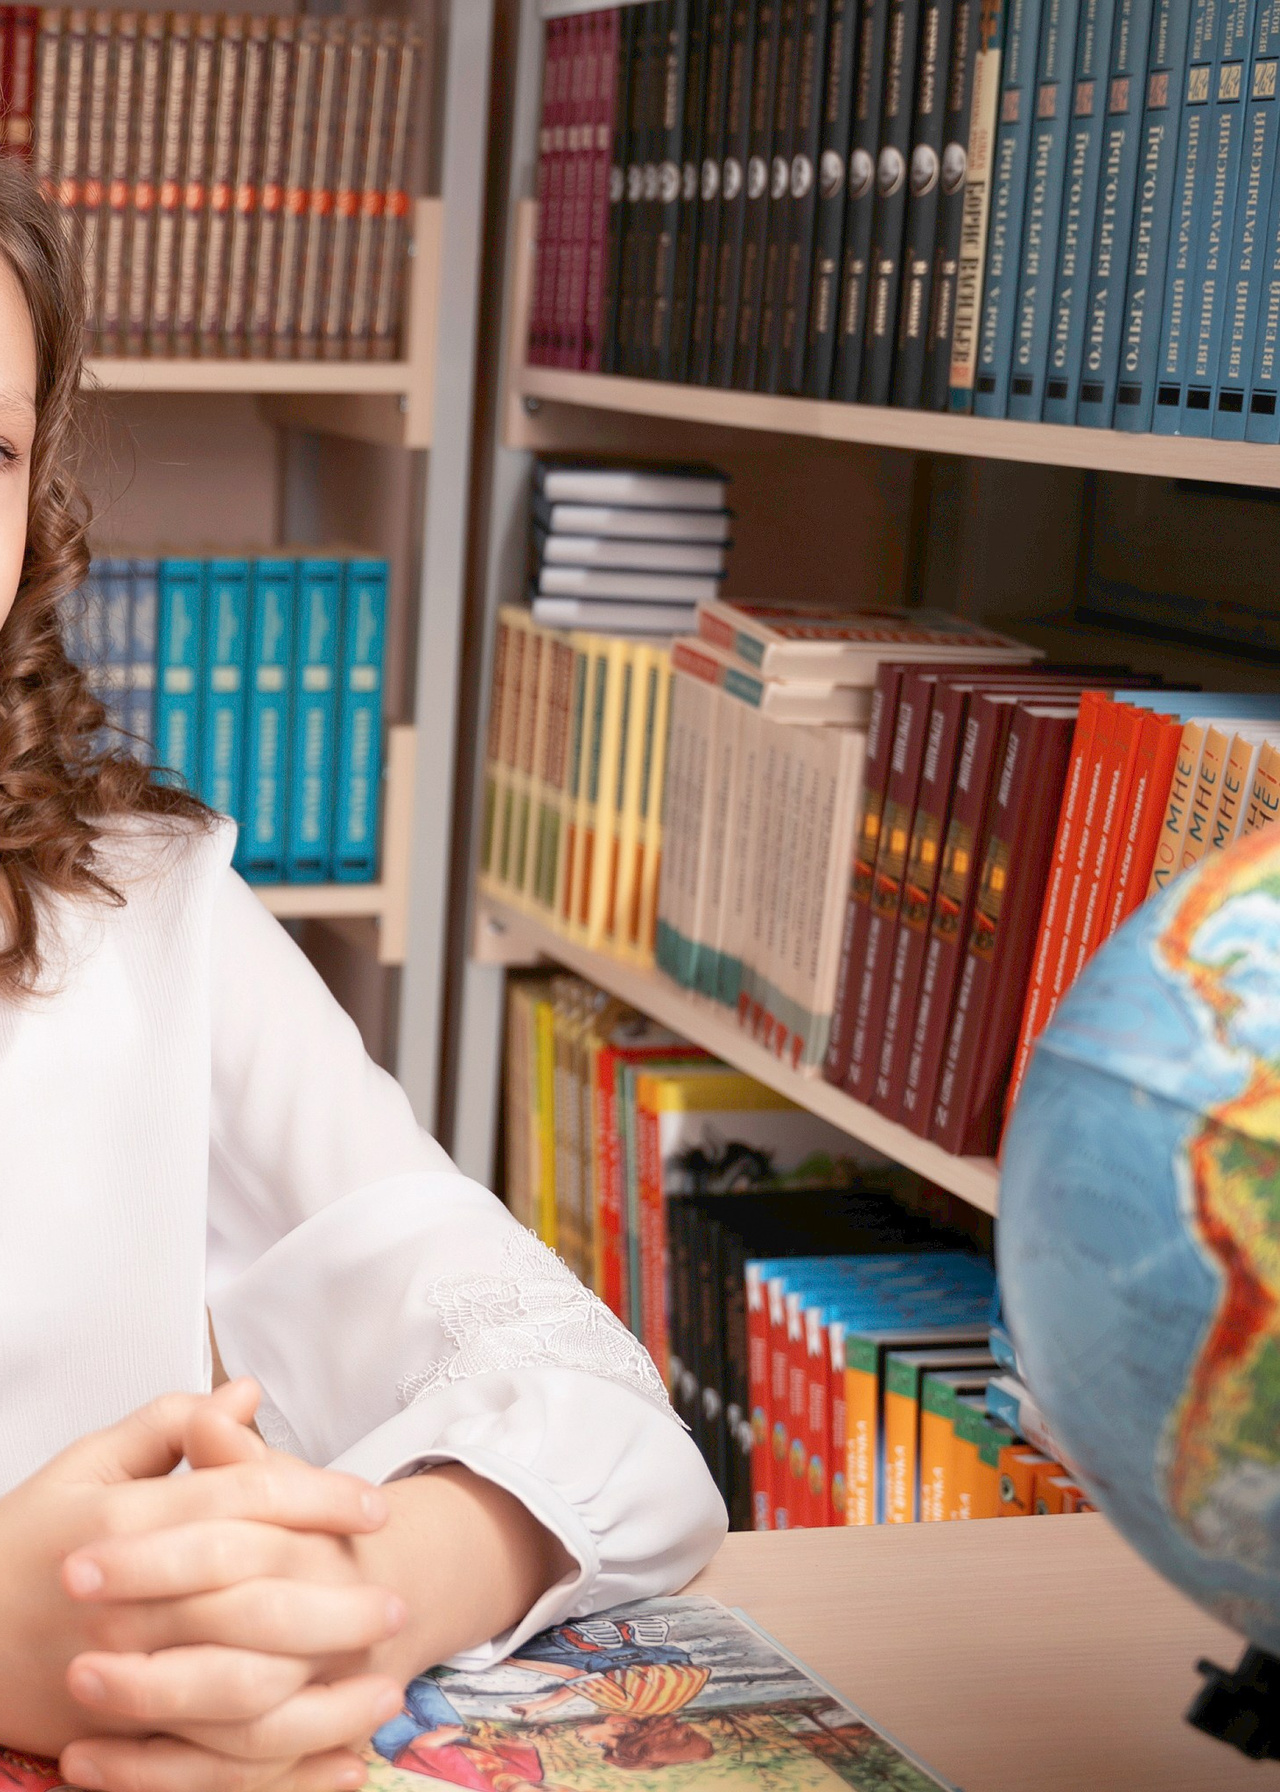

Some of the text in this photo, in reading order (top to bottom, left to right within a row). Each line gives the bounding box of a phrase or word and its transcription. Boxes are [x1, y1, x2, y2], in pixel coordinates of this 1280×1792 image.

[1087, 128, 1125, 371] ОЛЬГА БЕРГГОЛЬЦ
[1125, 125, 1164, 372] ОЛЬГА БЕРГГОЛЬЦ
[1166, 114, 1200, 374] ЕВГЕНИЙ БАРАТЫНСКИЙ
[1196, 113, 1231, 376] ЕВГЕНИЙ БАРАТЫНСКИЙ
[1228, 111, 1266, 378] ЕВГЕНИЙ БАРАТЫНСКИЙ
[983, 286, 1001, 364] ОЛЬГА
[1019, 285, 1037, 366] ОЛЬГА
[1053, 287, 1073, 368] ОЛЬГА
[1261, 280, 1280, 379] ЕВГЕНИЙ
[1154, 743, 1195, 889] ЛО МНЕ!
[1190, 750, 1218, 843] МНЕ!
[1213, 758, 1242, 850] МНЕ!
